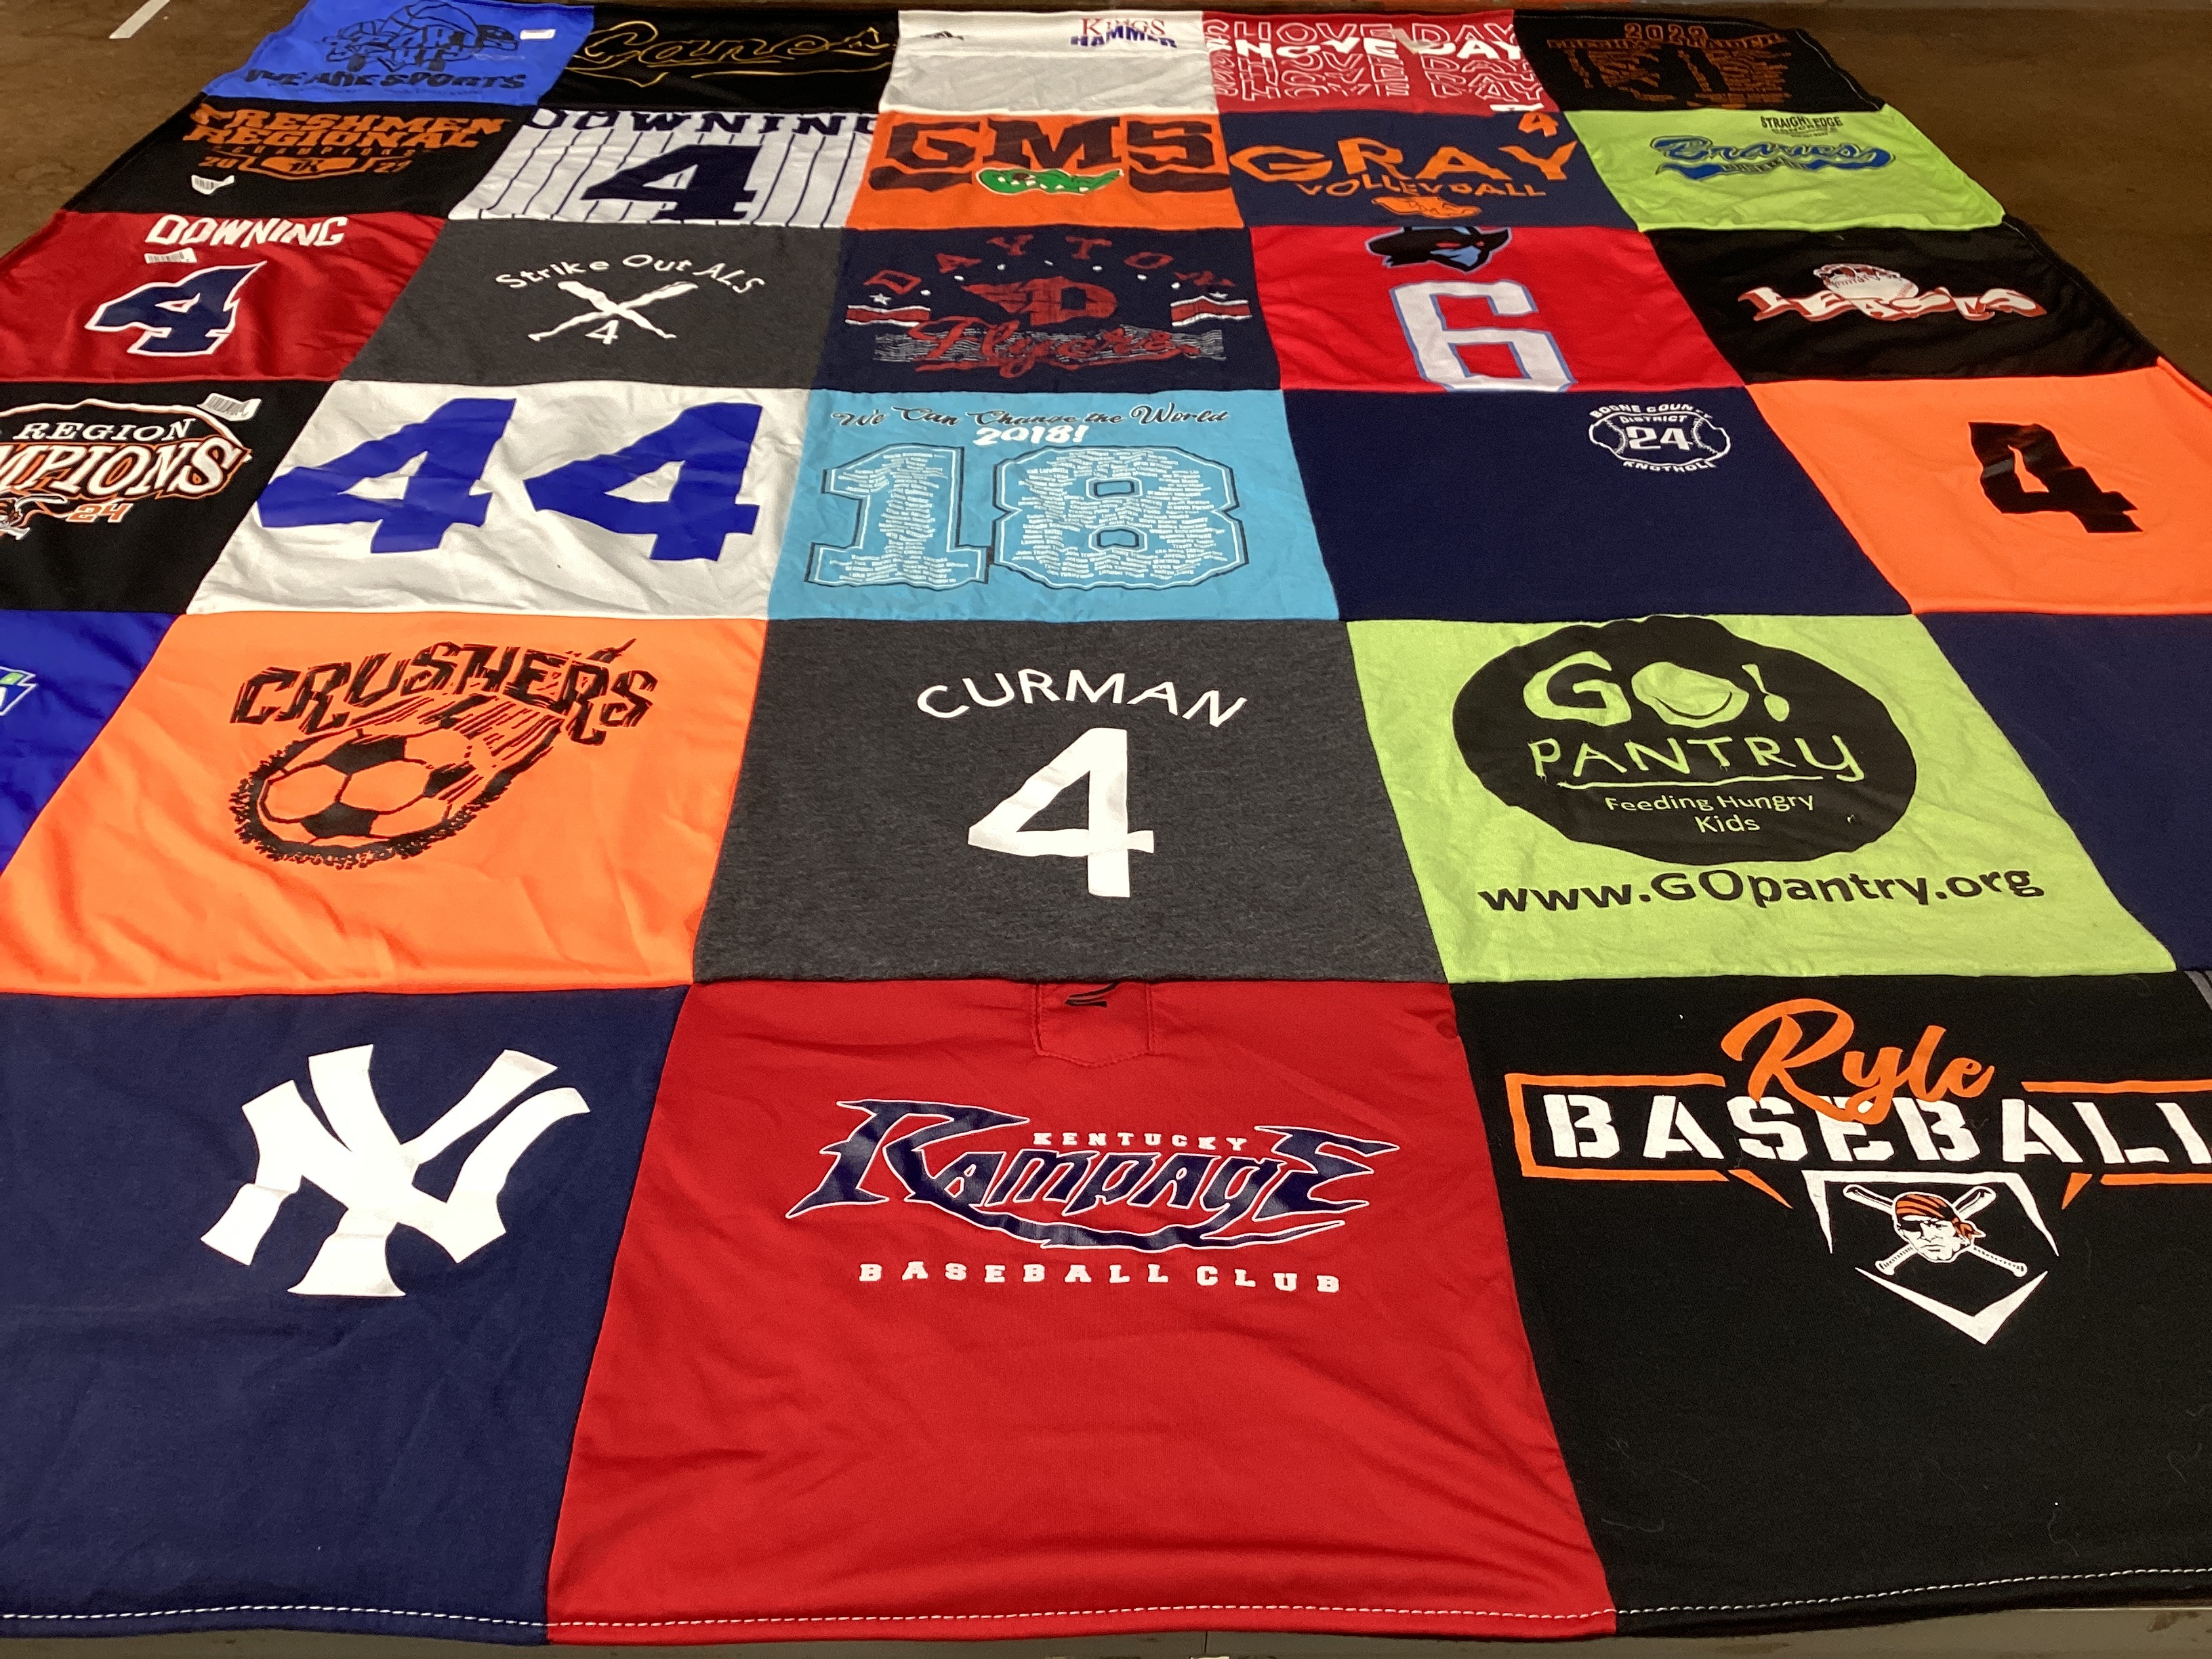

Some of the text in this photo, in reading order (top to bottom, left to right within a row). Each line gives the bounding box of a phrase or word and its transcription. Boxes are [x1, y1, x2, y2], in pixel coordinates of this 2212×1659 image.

[380, 70, 526, 89] SPORTS
[190, 103, 510, 134] FRESHMEN
[1519, 112, 1559, 136] 4
[1760, 115, 1843, 128] STRAIGHT EDGE
[183, 125, 478, 148] REGIONAL
[887, 117, 1216, 169] GMS
[199, 157, 239, 168] 20
[1229, 137, 1578, 182] GRAY
[581, 144, 762, 221] 4
[1296, 174, 1547, 197] VOLLEYBALL
[145, 215, 348, 248] DOWNING
[495, 253, 766, 294] Strike Out ALS
[863, 234, 1236, 295] DAYTON
[84, 260, 268, 357] 4
[585, 319, 619, 345] 4
[1389, 279, 1578, 393] 6
[832, 401, 1231, 426] We Can Change the World
[1589, 404, 1641, 418] BOONE
[1620, 415, 1687, 424] DISTRICT
[13, 417, 197, 442] REGION
[972, 424, 1090, 447] 2018!
[1626, 426, 1694, 451] 24
[256, 397, 763, 562] 44
[1968, 422, 2144, 533] 4
[66, 501, 134, 523] 24
[804, 443, 1249, 592] 18
[230, 641, 657, 745] CRUSHERS
[917, 668, 1248, 728] CURMAN
[1523, 651, 1790, 728] GO!
[1528, 735, 1865, 783] PANTRY
[968, 727, 1154, 897] 4
[1605, 794, 1815, 813] Feeding Hungry
[1694, 816, 1761, 834] Kids
[1479, 867, 2045, 912] www.GOpantry.org
[1721, 998, 1995, 1125] Ryle
[1033, 1132, 1248, 1153] KENTUCKY
[859, 1262, 1341, 1294] BASEBALL CLUB
